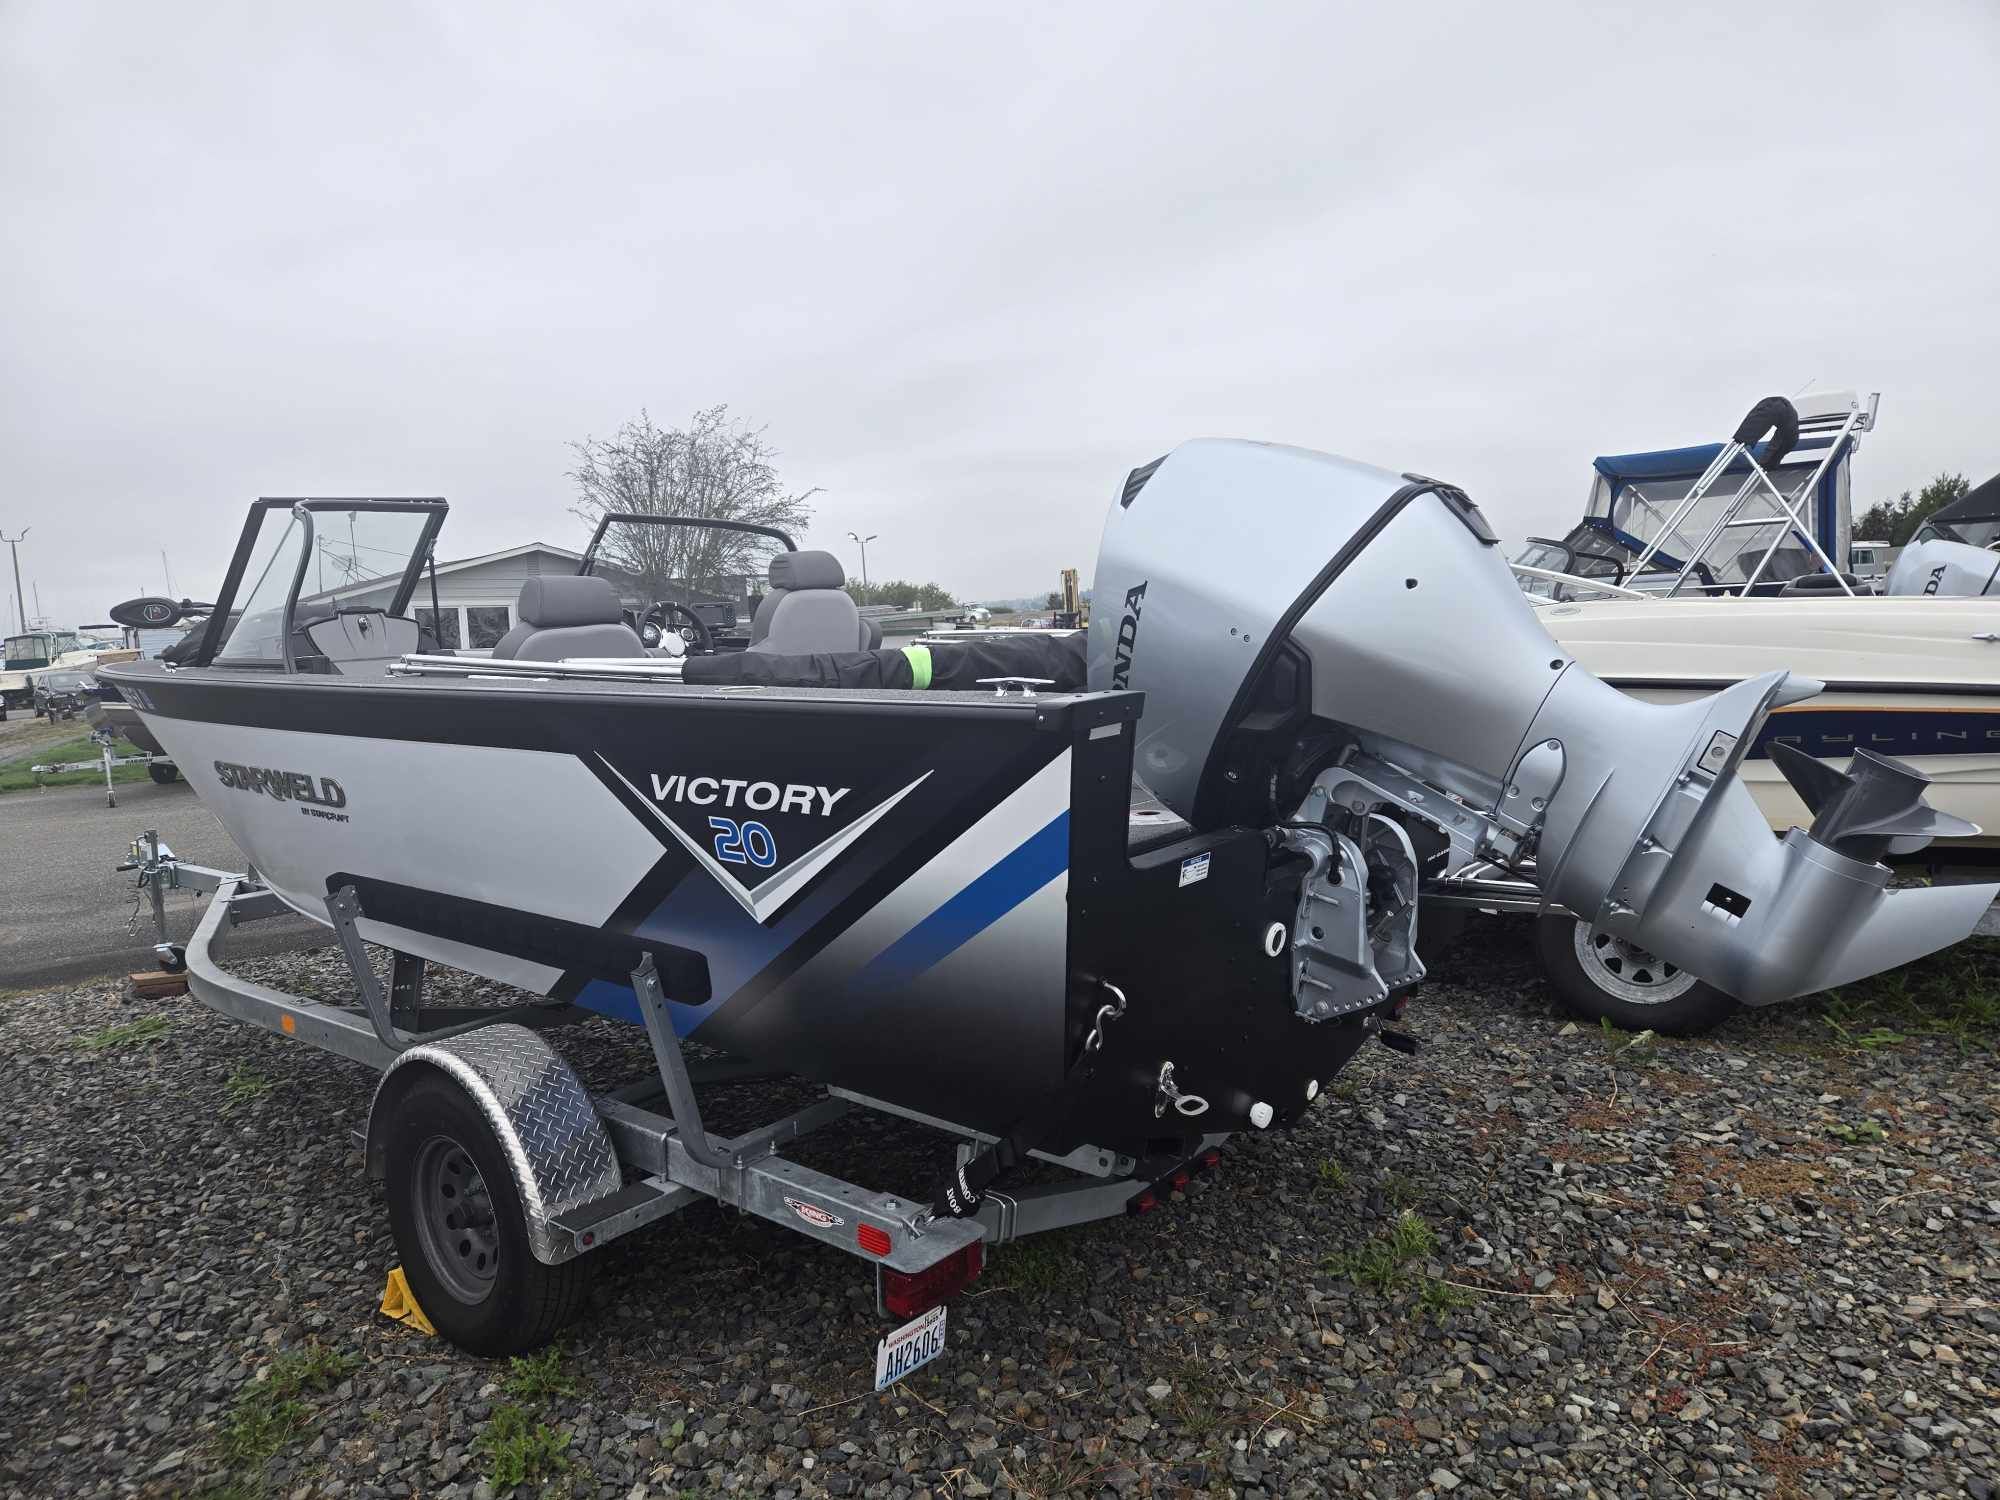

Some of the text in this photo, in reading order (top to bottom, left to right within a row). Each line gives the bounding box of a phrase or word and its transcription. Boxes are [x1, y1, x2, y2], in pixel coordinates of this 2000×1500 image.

[1112, 580, 1148, 690] NDA
[214, 760, 347, 808] STARWELD
[650, 773, 852, 816] VICTORY
[708, 815, 777, 868] 20
[946, 1187, 962, 1214] BOAT
[884, 1325, 939, 1384] AH2606
